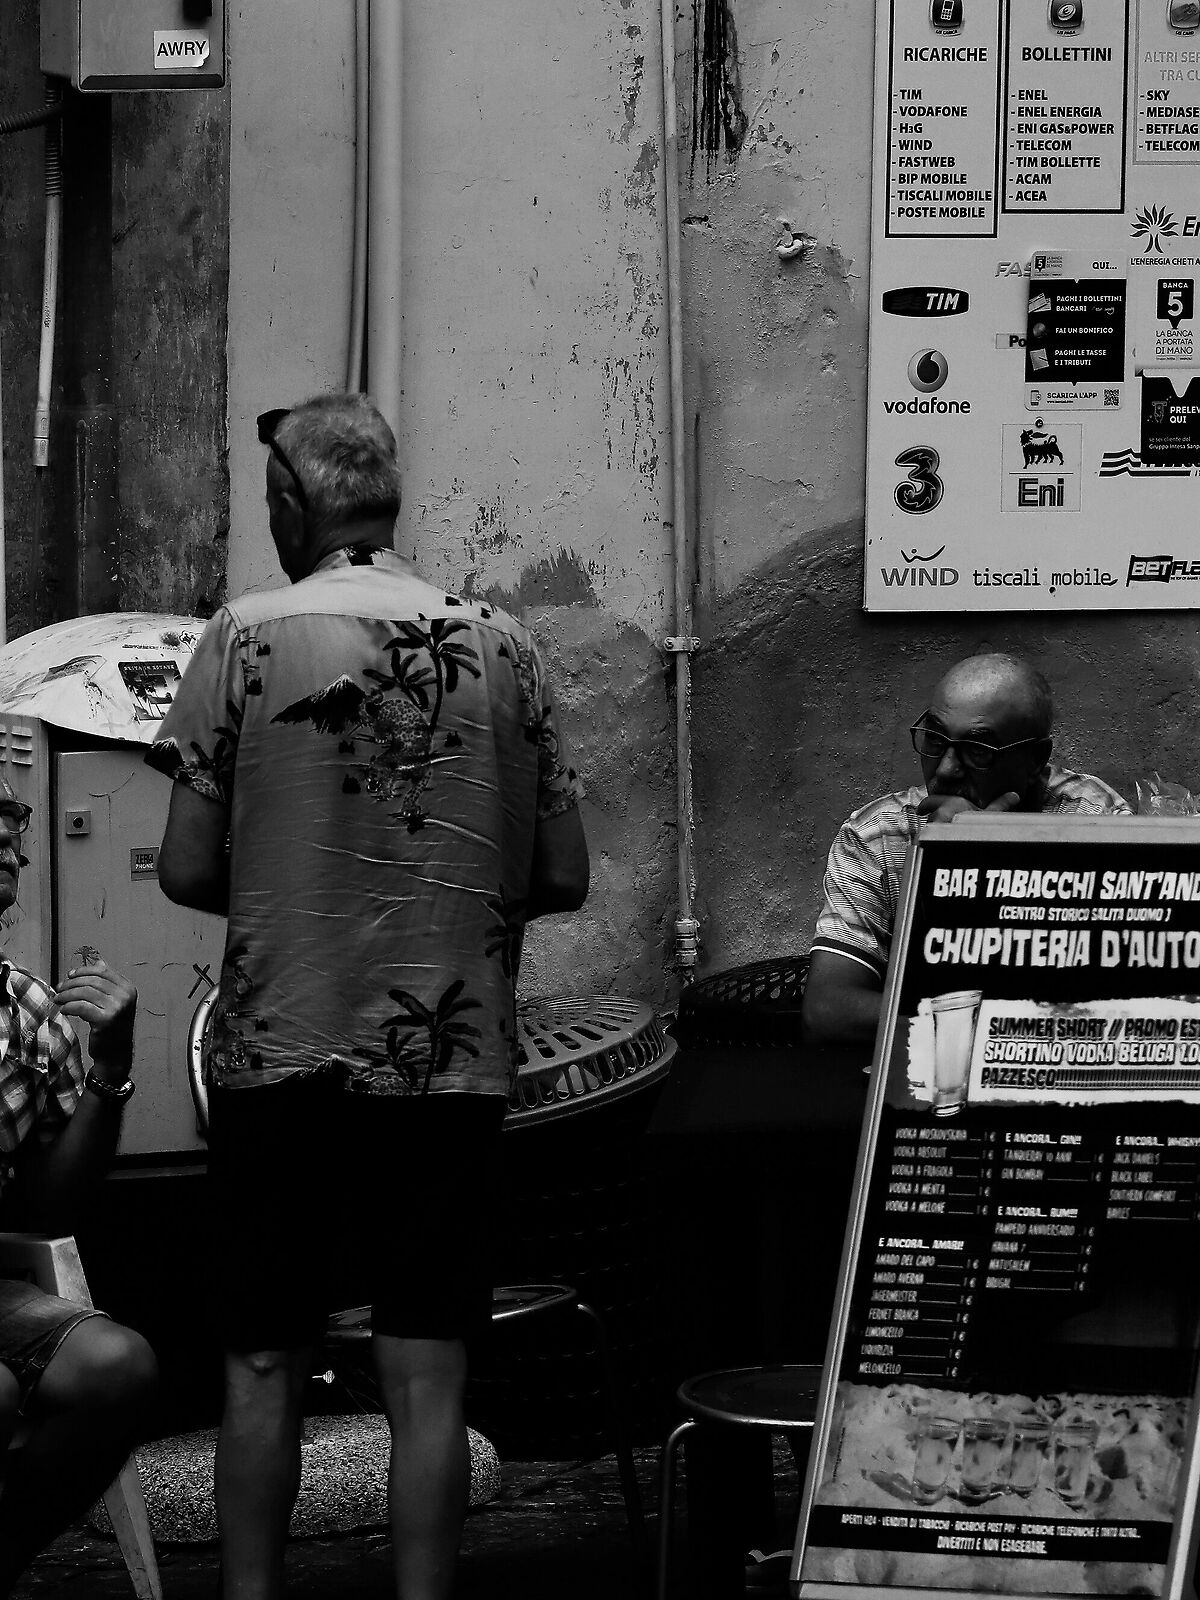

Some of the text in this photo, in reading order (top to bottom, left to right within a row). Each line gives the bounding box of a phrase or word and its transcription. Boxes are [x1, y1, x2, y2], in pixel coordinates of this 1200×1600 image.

[157, 40, 207, 57] AWRY
[904, 47, 987, 62] RICARICHE
[1022, 47, 1111, 62] BOLLETTINI
[1144, 51, 1178, 63] ALTRI
[1160, 69, 1183, 81] TRA
[899, 89, 922, 101] TIM
[1018, 89, 1048, 101] ENEL
[1146, 90, 1170, 101] SKY
[899, 106, 968, 117] VODAFONE
[1018, 106, 1102, 118] ENEL ENERGIA
[1146, 106, 1200, 118] MEDIASE
[899, 123, 923, 134] H3G
[1017, 124, 1115, 135] ENI GAS&POWER
[1146, 123, 1199, 135] BETFLAG
[899, 140, 933, 151] WIND
[1016, 140, 1072, 152] TELECOM
[1145, 140, 1200, 151] TELECOM
[899, 157, 956, 168] FASTWEB
[1016, 157, 1101, 168] TIM BOLLETTE
[899, 174, 967, 185] BIP MOBILE
[1016, 174, 1052, 185] ACAM
[897, 191, 992, 202] TISCALI MOBILE
[1015, 191, 1047, 202] ACEA
[897, 207, 985, 219] POSTE MOBILE
[1130, 258, 1170, 266] L'ENEREGIA
[1171, 258, 1188, 266] CHE
[926, 293, 960, 311] TIM
[1167, 291, 1184, 317] 5
[1166, 329, 1193, 338] BANCA
[1009, 336, 1026, 347] Po
[1155, 346, 1193, 355] DI MANO
[884, 396, 971, 414] vodafone
[1169, 415, 1187, 424] QUI
[894, 445, 945, 515] 3
[1018, 478, 1064, 507] Eni
[881, 567, 960, 587] WIND
[973, 568, 1112, 587] tiscali mobile
[933, 868, 979, 898] BAR
[985, 869, 1096, 900] TABACCHI
[1047, 906, 1089, 922] STORICO
[1091, 907, 1124, 921] SALITA
[1126, 908, 1163, 922] DUOMO
[923, 927, 1200, 969] CHUPITERIA D'AUTO
[988, 1016, 1055, 1039] SUMMER
[1057, 1017, 1107, 1039] SHORT
[1124, 1018, 1179, 1039] PROMO
[984, 1040, 1177, 1065] SHORTINO VODKA BELUGA
[895, 1128, 917, 1139] VODKA
[1005, 1132, 1012, 1143] E
[1115, 1135, 1122, 1146] E
[893, 1146, 947, 1158] VODKA ABSOLUT
[891, 1164, 953, 1177] VODKA A FRAGOLA
[889, 1182, 945, 1195] VODKA A MENTA
[885, 1200, 946, 1213] VODKA A MELONE
[997, 1206, 1003, 1216] E
[878, 1237, 885, 1247] E
[875, 1254, 935, 1267] AMARO DEL CAPO
[872, 1272, 896, 1283] AMARO
[868, 1308, 919, 1320] FERNET BRANCA
[864, 1326, 904, 1338] LIMONCELLO
[858, 1362, 902, 1374] MELONCELLO
[841, 1513, 863, 1525] APERTI
[937, 1535, 999, 1551] DIVERTITI E NON
